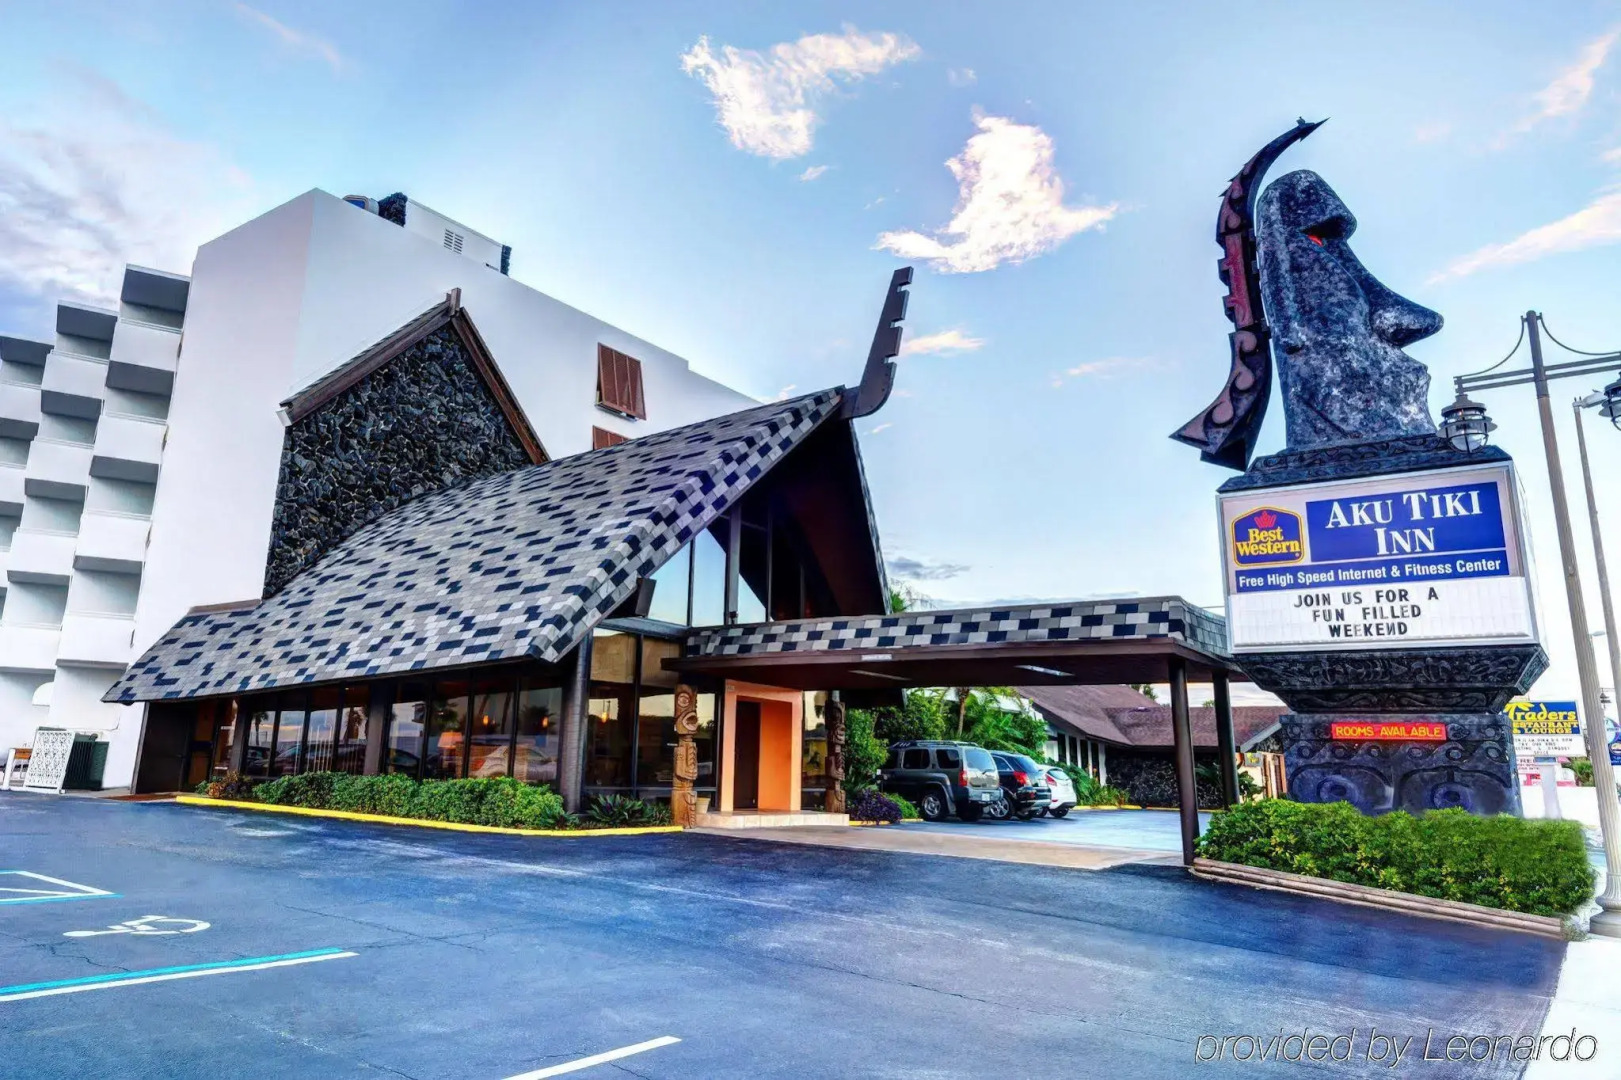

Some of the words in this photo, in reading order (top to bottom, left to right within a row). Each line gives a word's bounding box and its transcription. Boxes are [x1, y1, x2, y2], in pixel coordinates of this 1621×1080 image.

[1325, 500, 1393, 528] AKU
[1403, 490, 1482, 521] TIKI
[1248, 526, 1284, 543] Best
[1374, 527, 1435, 556] INN
[1236, 540, 1300, 557] Western
[1239, 576, 1264, 587] Free
[1267, 573, 1294, 587] High
[1297, 570, 1335, 585] Speed
[1338, 565, 1387, 581] Internet
[1391, 565, 1400, 577] &
[1405, 562, 1453, 576] Fitness
[1456, 558, 1501, 573] Center
[1294, 593, 1331, 608] JOIN
[1342, 591, 1363, 605] US
[1375, 588, 1410, 603] FOR
[1428, 586, 1439, 601] A
[1313, 608, 1345, 622] FUN
[1362, 604, 1421, 620] FILLED
[1329, 621, 1408, 638] WEEKEND
[1503, 702, 1577, 721] Traders
[1336, 726, 1374, 736] ROOMS
[1380, 726, 1442, 737] AVAILABLE
